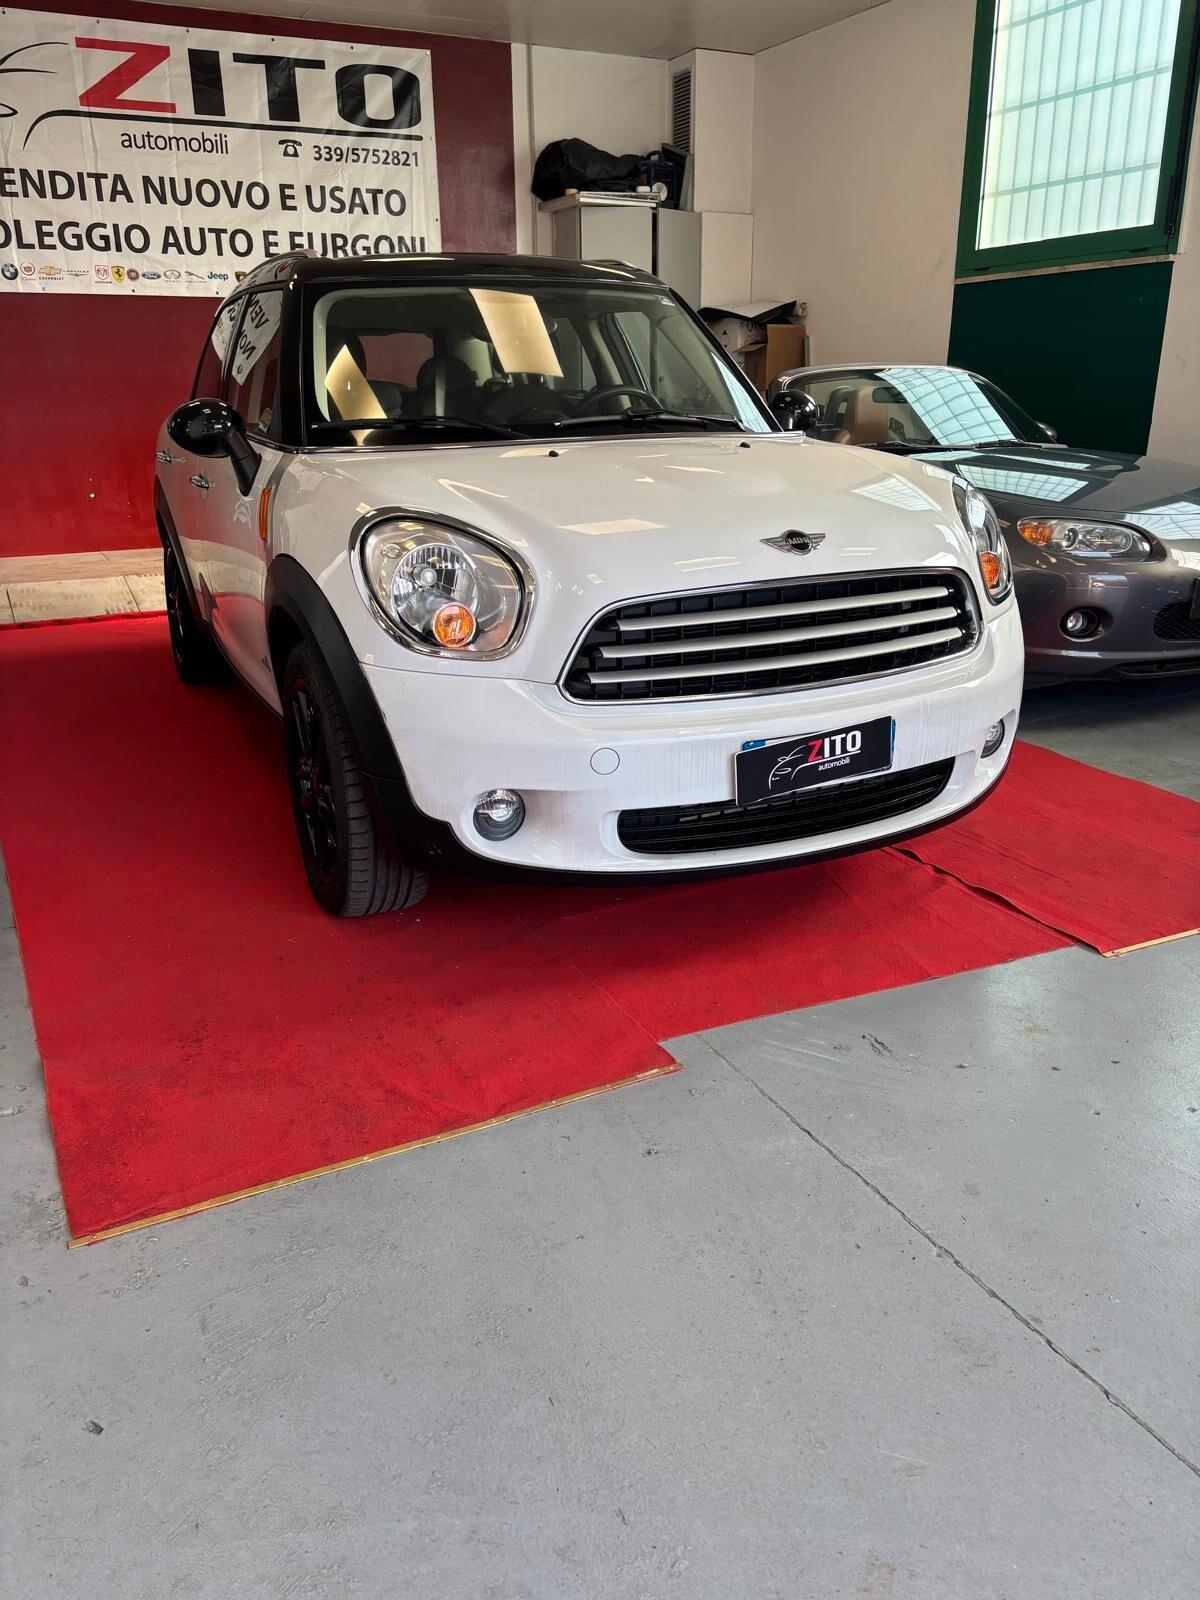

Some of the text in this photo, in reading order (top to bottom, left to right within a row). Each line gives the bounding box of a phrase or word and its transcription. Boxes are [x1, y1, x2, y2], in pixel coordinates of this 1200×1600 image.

[75, 37, 422, 130] ZITO
[120, 132, 229, 155] automobili
[313, 145, 420, 167] 339/5752821
[142, 175, 270, 211] NUOVO
[279, 184, 298, 212] E
[305, 184, 407, 217] USATO
[162, 225, 253, 258] AUTO
[263, 230, 279, 258] E
[208, 271, 229, 281] Jeep
[787, 536, 809, 545] MINI
[808, 731, 862, 763] ZITO
[818, 757, 850, 771] automobili
